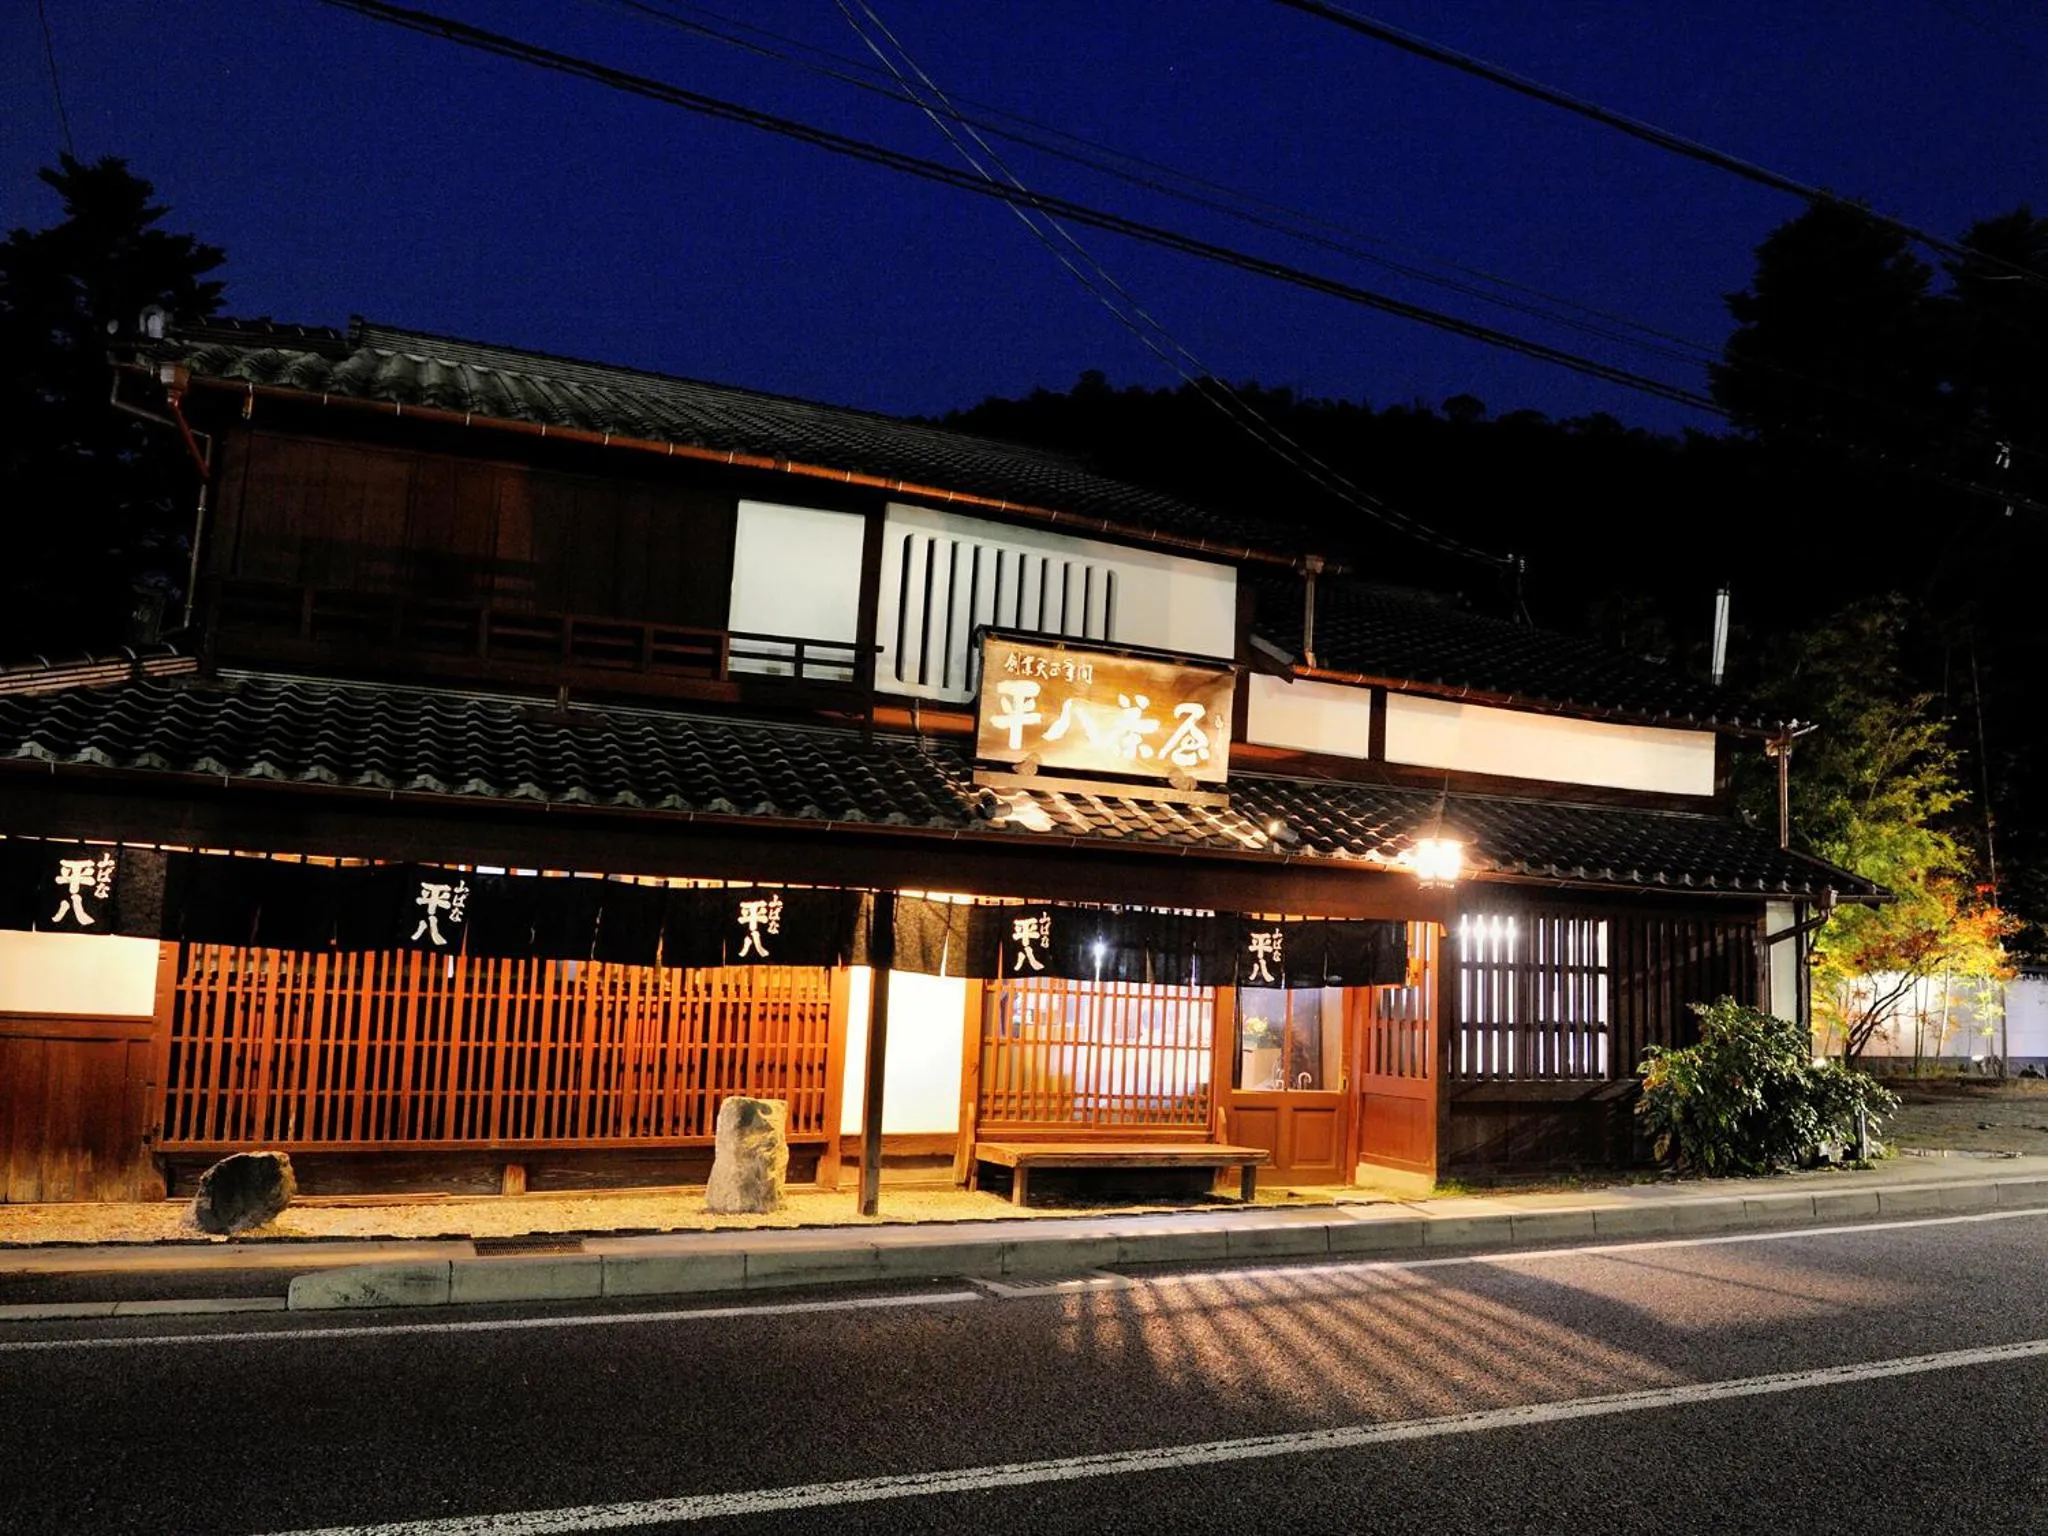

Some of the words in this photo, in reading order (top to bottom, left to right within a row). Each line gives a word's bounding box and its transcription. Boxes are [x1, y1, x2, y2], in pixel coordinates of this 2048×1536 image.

[989, 679, 1211, 767] 平八茶屋
[51, 859, 97, 926] 平八
[410, 881, 452, 946] 平八
[738, 899, 770, 958] 平八
[1012, 917, 1045, 971] 平八
[1248, 932, 1276, 983] 平八
